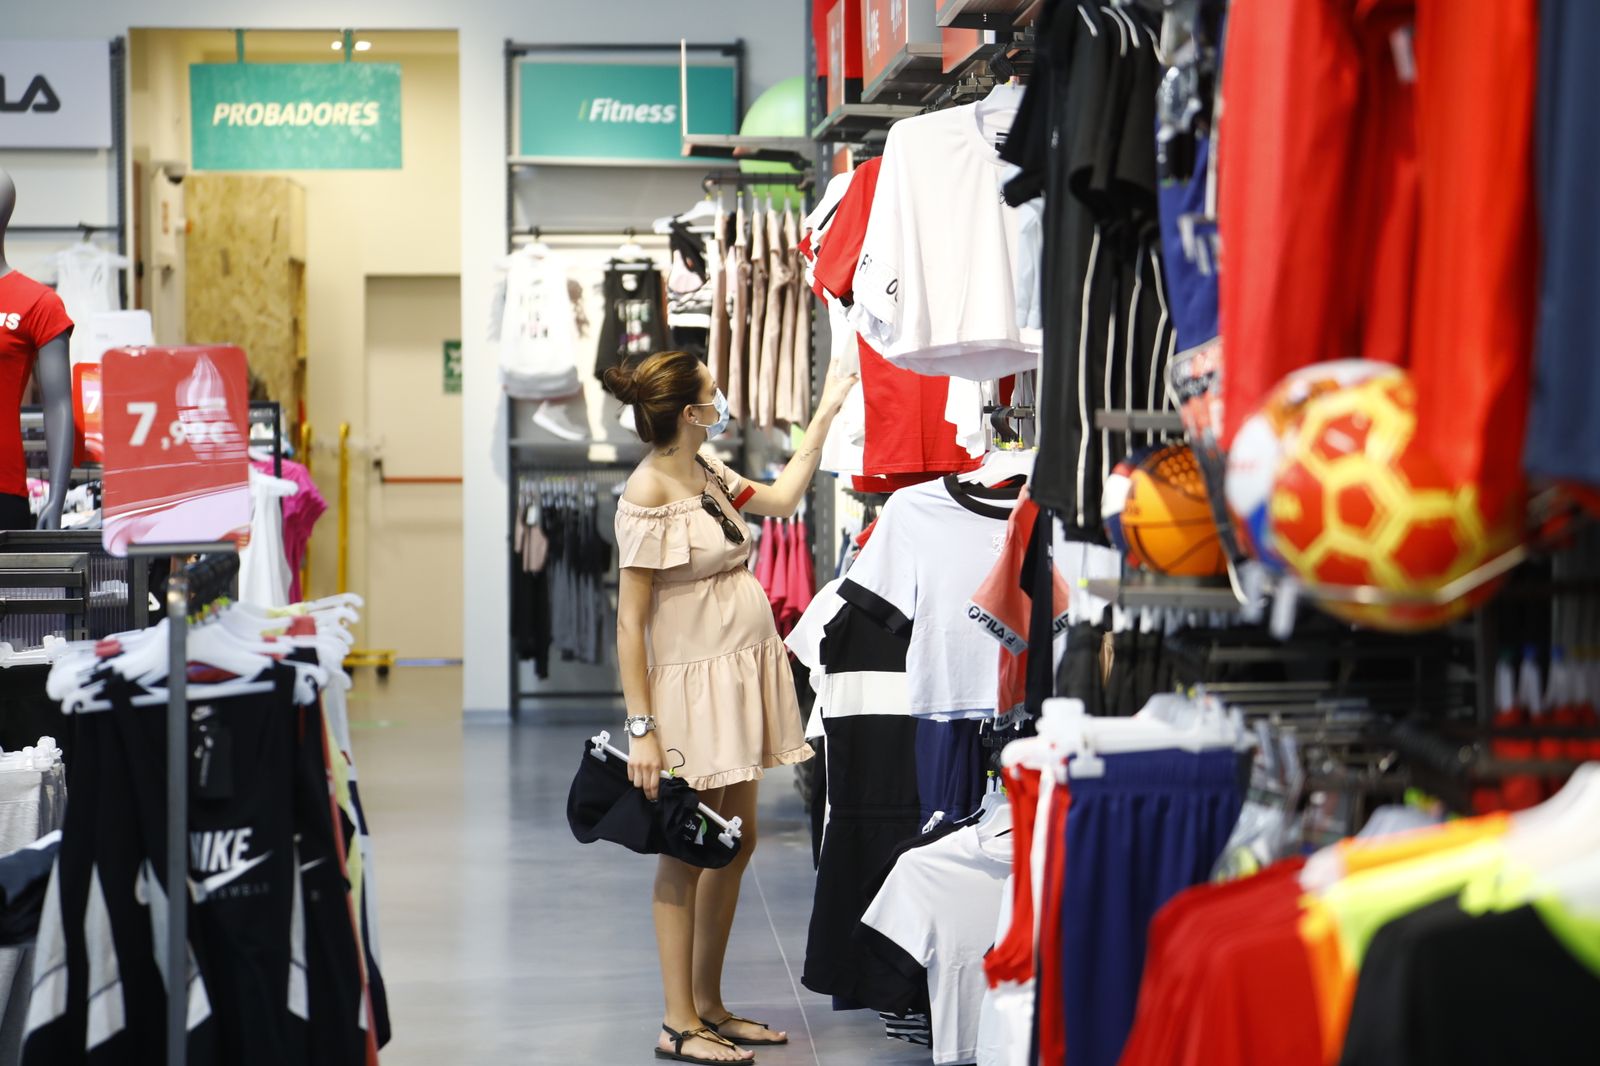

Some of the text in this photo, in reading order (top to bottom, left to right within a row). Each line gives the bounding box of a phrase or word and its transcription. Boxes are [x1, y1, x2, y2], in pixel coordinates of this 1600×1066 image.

[212, 101, 380, 126] PROBADORES
[589, 97, 677, 123] Fitness
[978, 612, 1006, 639] FILA
[996, 713, 1010, 727] ILA
[190, 827, 253, 872] NIKE
